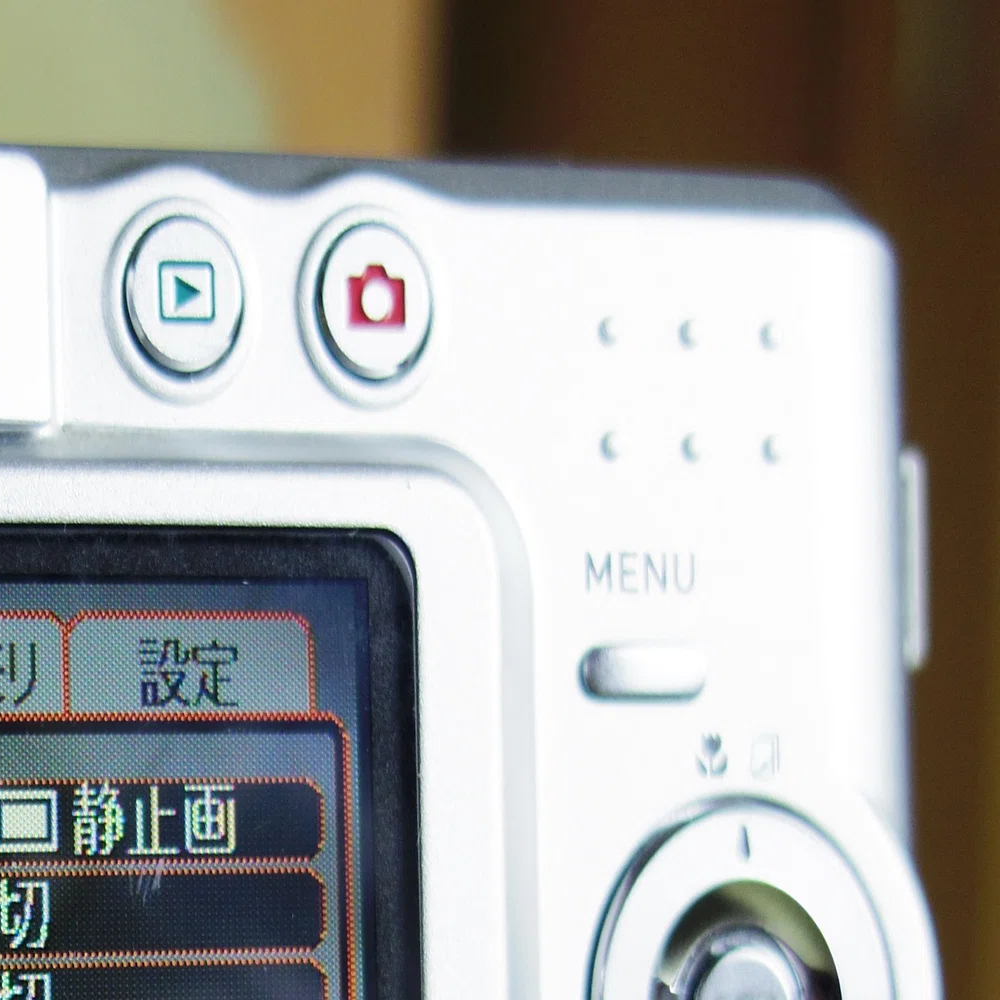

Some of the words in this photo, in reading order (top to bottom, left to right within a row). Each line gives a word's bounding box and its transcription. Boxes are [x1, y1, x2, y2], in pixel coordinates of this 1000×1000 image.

[584, 550, 697, 594] MENU
[139, 638, 240, 707] 設定
[71, 780, 237, 857] 静止画
